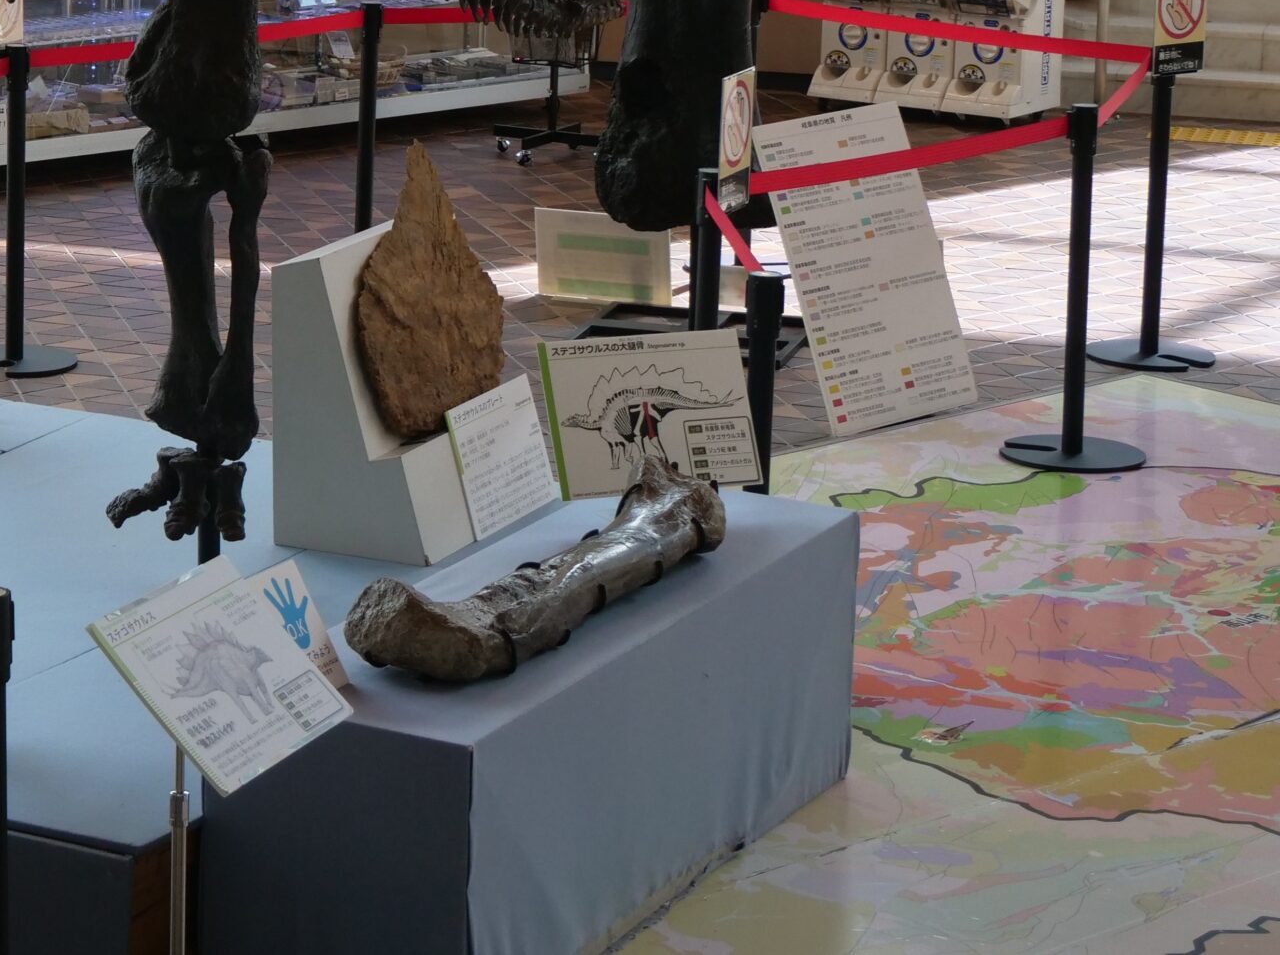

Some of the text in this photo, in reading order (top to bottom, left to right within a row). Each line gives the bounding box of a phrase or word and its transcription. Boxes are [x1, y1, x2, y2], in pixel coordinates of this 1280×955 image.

[106, 611, 157, 644] ステゴサウルス
